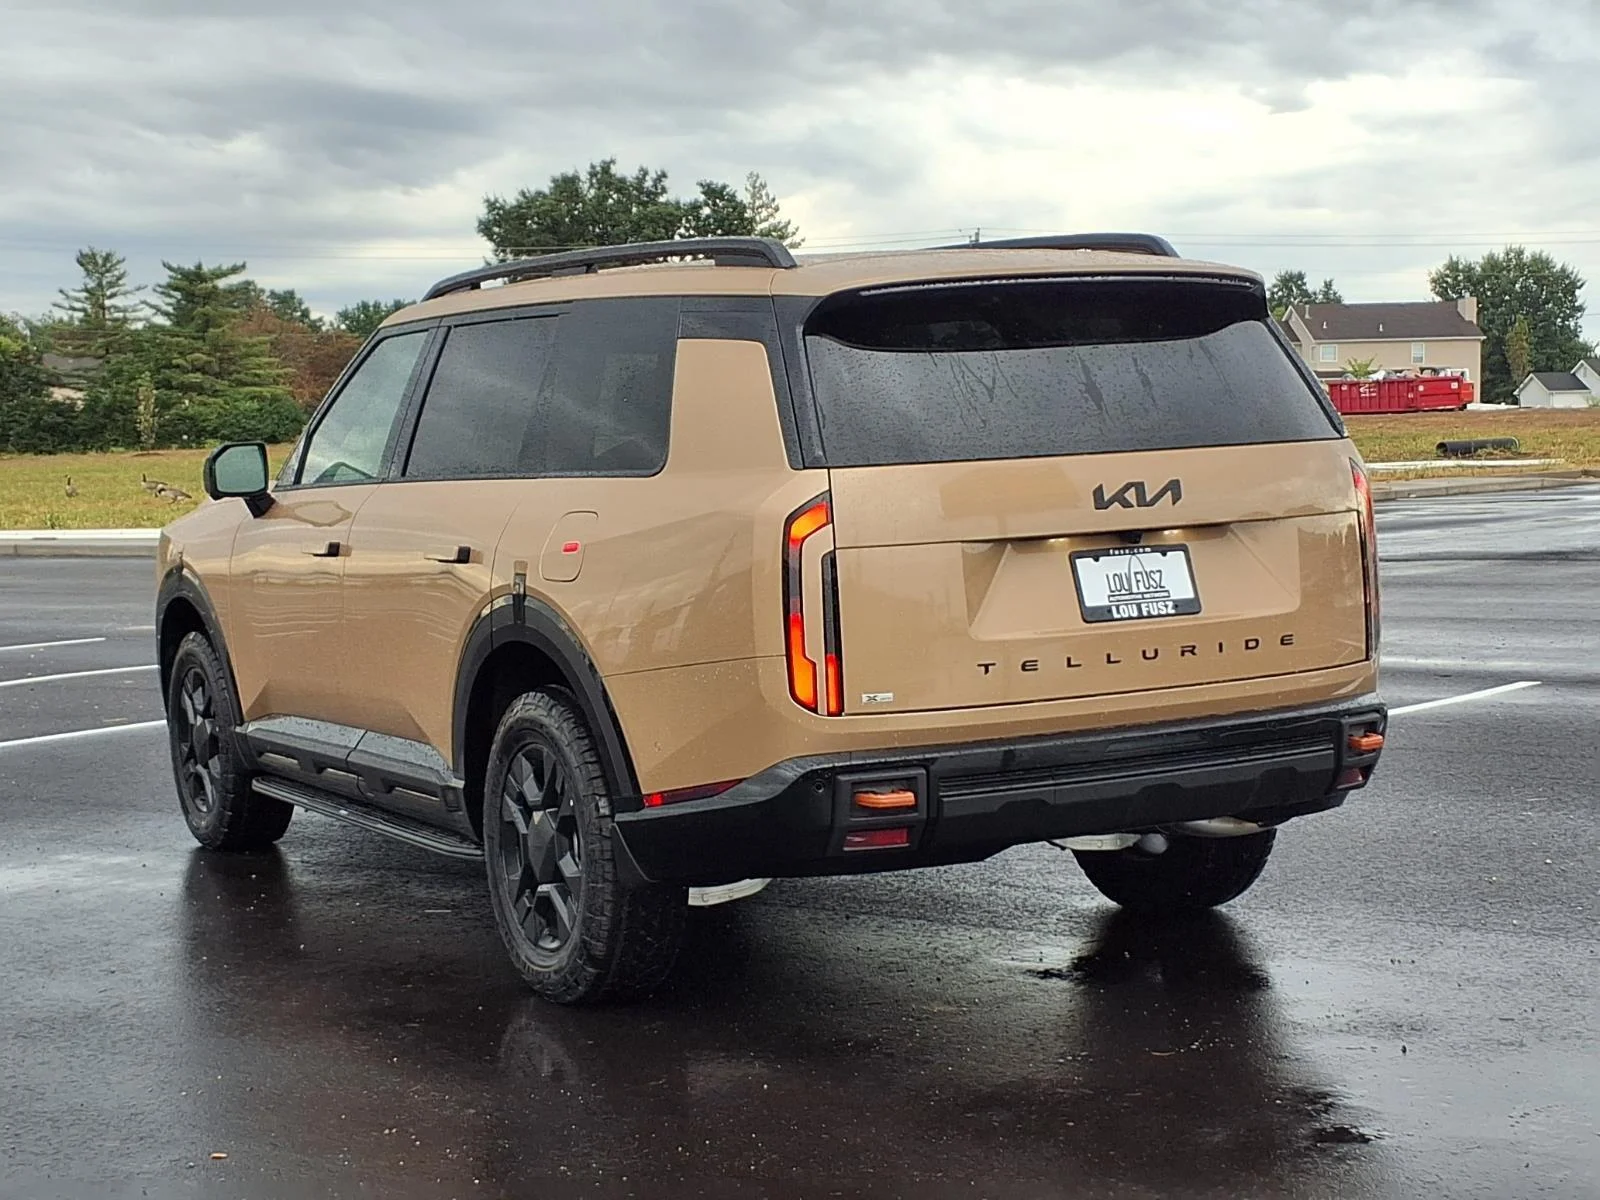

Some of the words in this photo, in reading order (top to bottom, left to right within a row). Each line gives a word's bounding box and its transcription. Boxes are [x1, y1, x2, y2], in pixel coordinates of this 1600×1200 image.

[1106, 573, 1130, 593] LOU
[1134, 570, 1166, 590] FUSZ
[1111, 604, 1138, 619] LOU
[1141, 602, 1176, 618] FUSZ
[977, 634, 1294, 675] TELLURIDE
